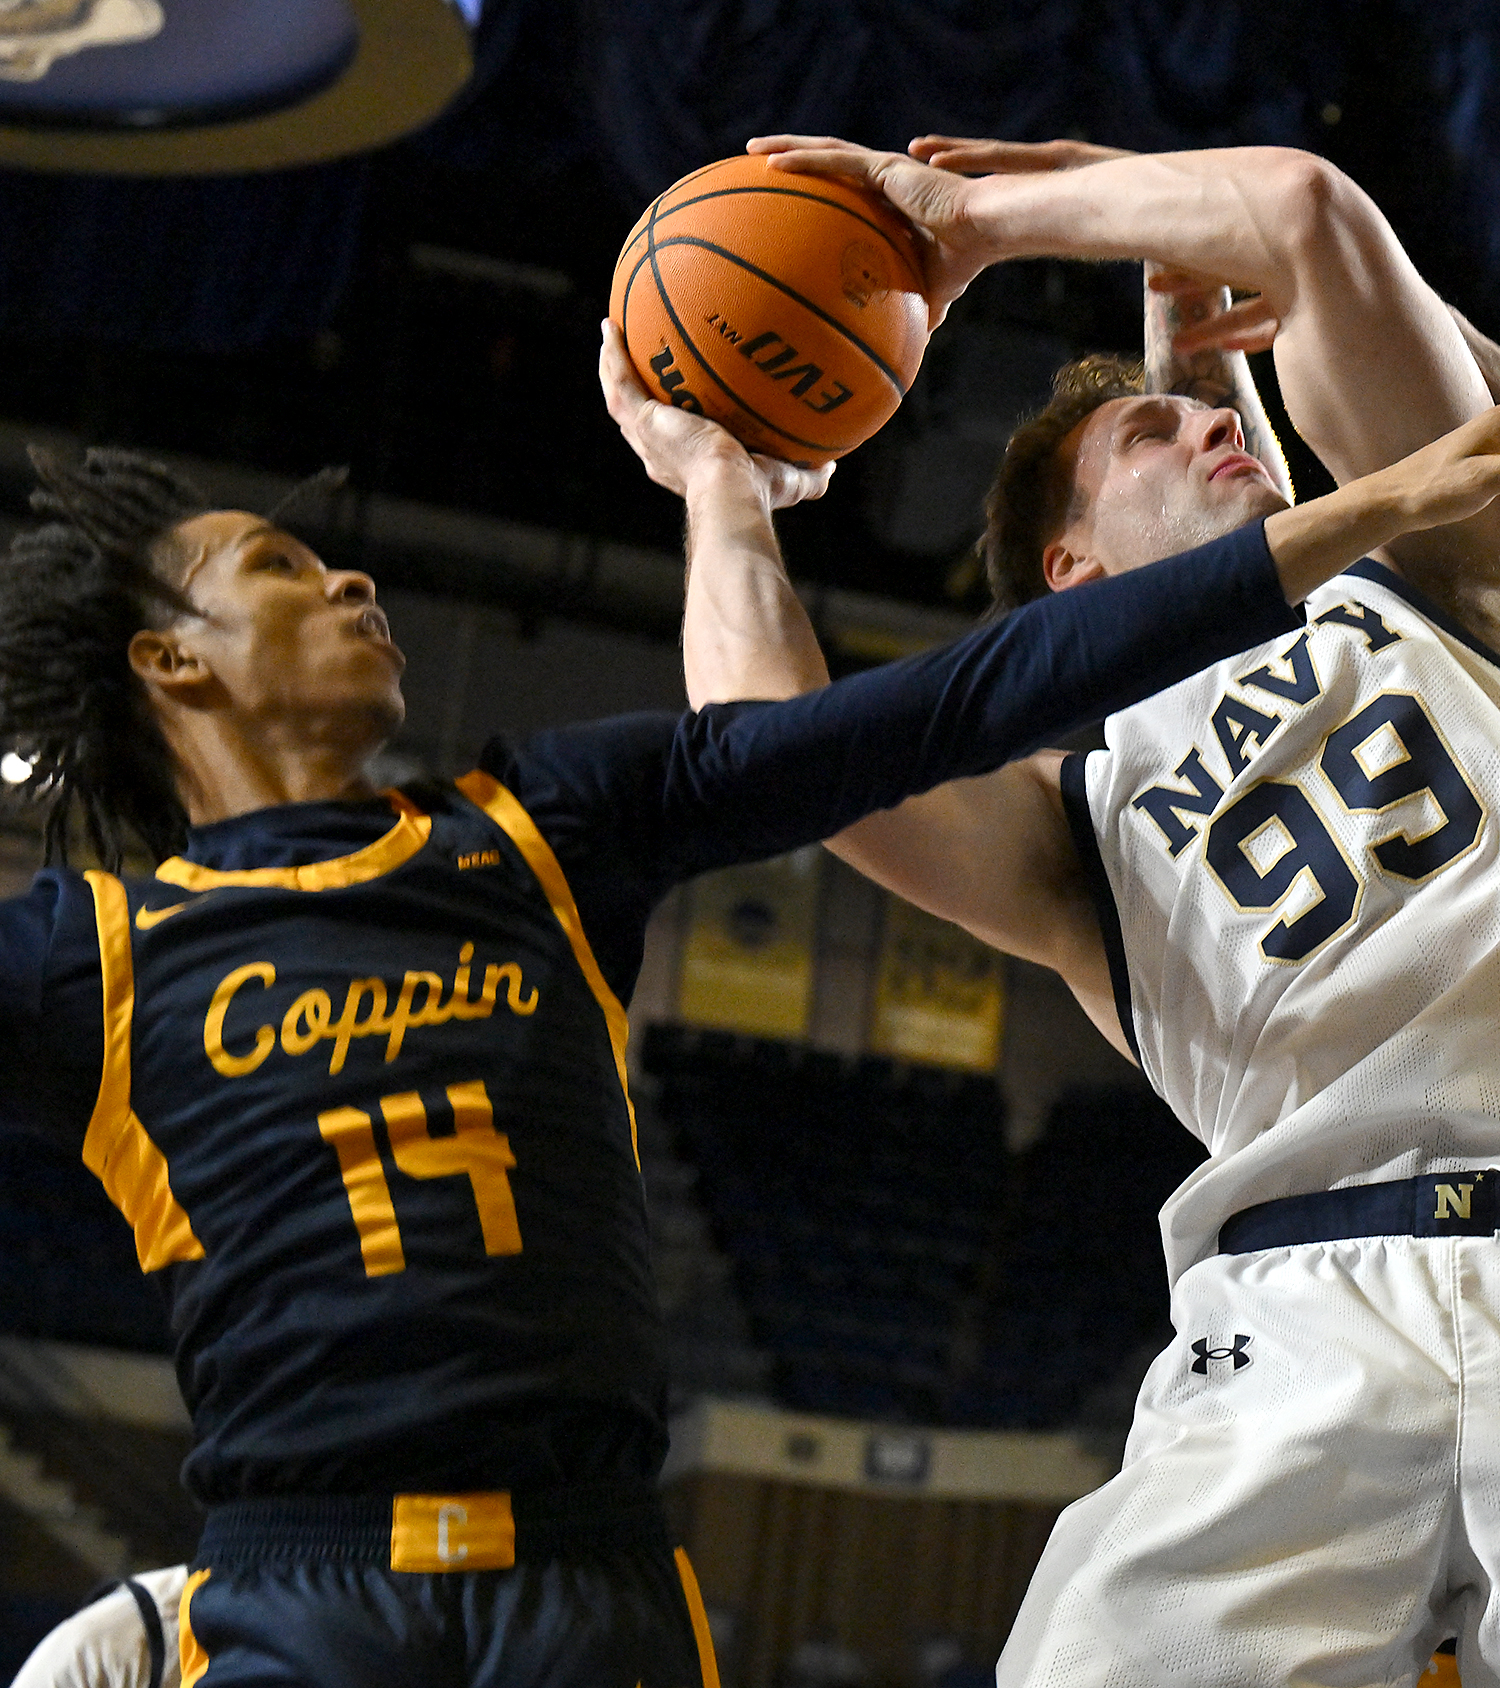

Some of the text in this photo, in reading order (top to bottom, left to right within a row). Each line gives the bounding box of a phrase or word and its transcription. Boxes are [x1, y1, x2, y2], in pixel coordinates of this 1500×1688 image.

[707, 314, 853, 413] EVO NXT
[1130, 600, 1404, 861] NAVY
[1201, 687, 1488, 966] 99
[203, 942, 539, 1077] Coppin
[317, 1080, 523, 1278] 14
[1434, 1183, 1475, 1219] N
[437, 1503, 469, 1565] C
